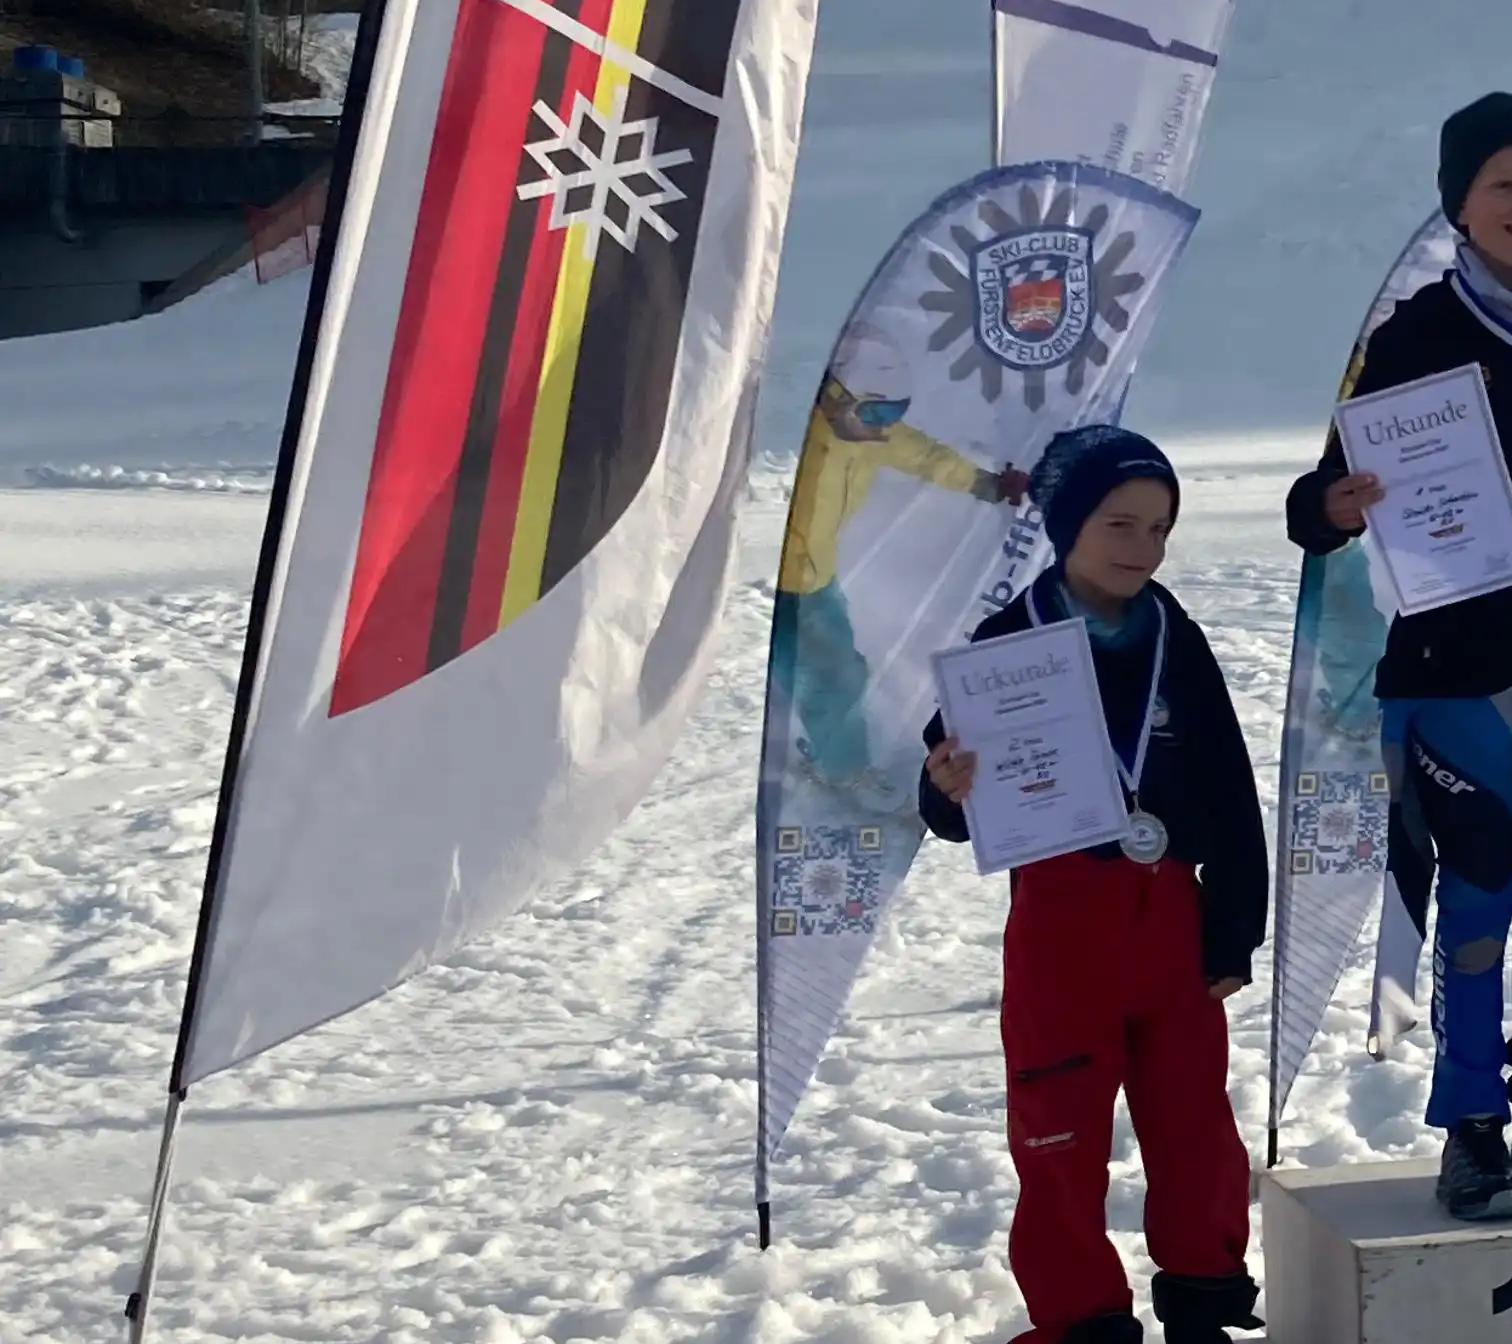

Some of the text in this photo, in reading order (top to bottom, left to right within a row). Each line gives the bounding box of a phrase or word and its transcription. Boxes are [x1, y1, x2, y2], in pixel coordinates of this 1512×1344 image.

[988, 236, 1081, 265] SKI-CLUB
[1363, 400, 1468, 446] Urkunde
[961, 653, 1071, 697] Urkunde
